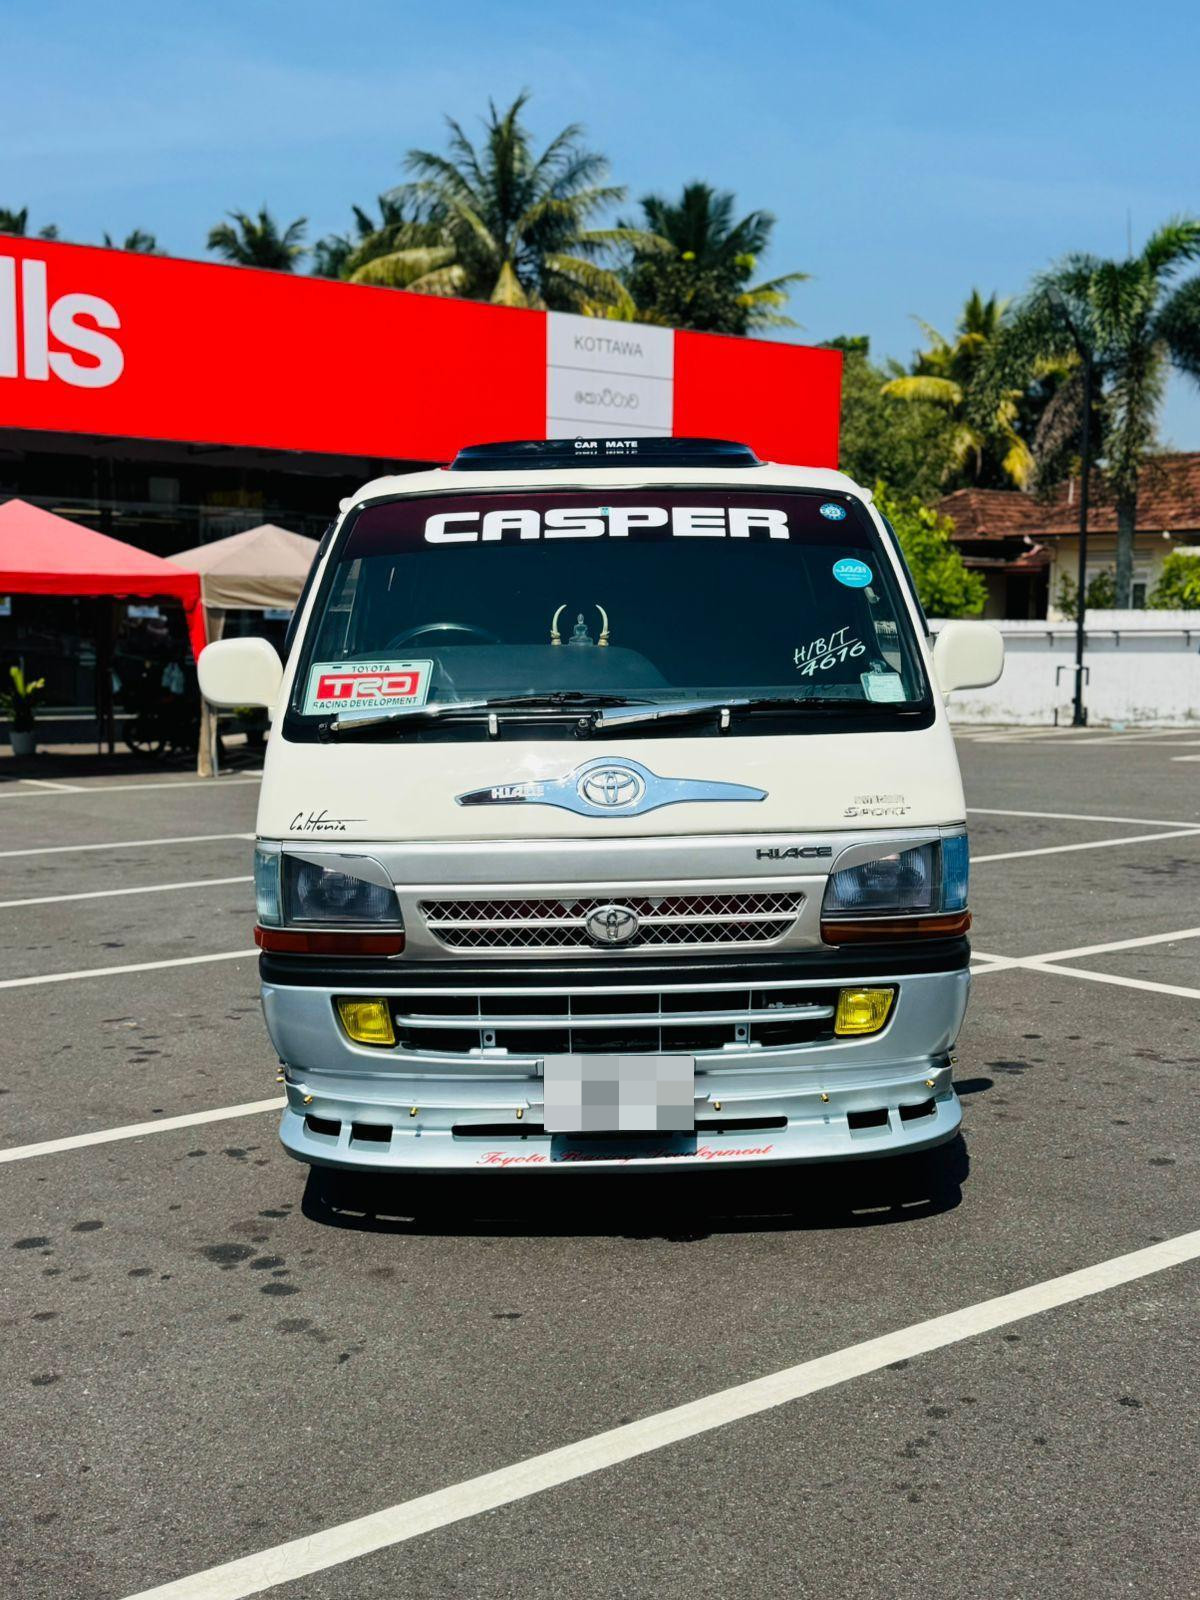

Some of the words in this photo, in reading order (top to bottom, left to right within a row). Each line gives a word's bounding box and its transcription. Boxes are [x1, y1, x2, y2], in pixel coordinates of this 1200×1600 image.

[574, 336, 643, 357] KOTTAWA
[605, 440, 638, 448] MATE
[424, 506, 790, 543] CASPER
[352, 664, 391, 673] TOYOTA
[323, 675, 412, 697] TRD
[313, 700, 348, 710] RACING
[349, 696, 418, 708] DEVELOPMENT
[756, 846, 833, 860] HIACE
[476, 1151, 548, 1167] Toyota
